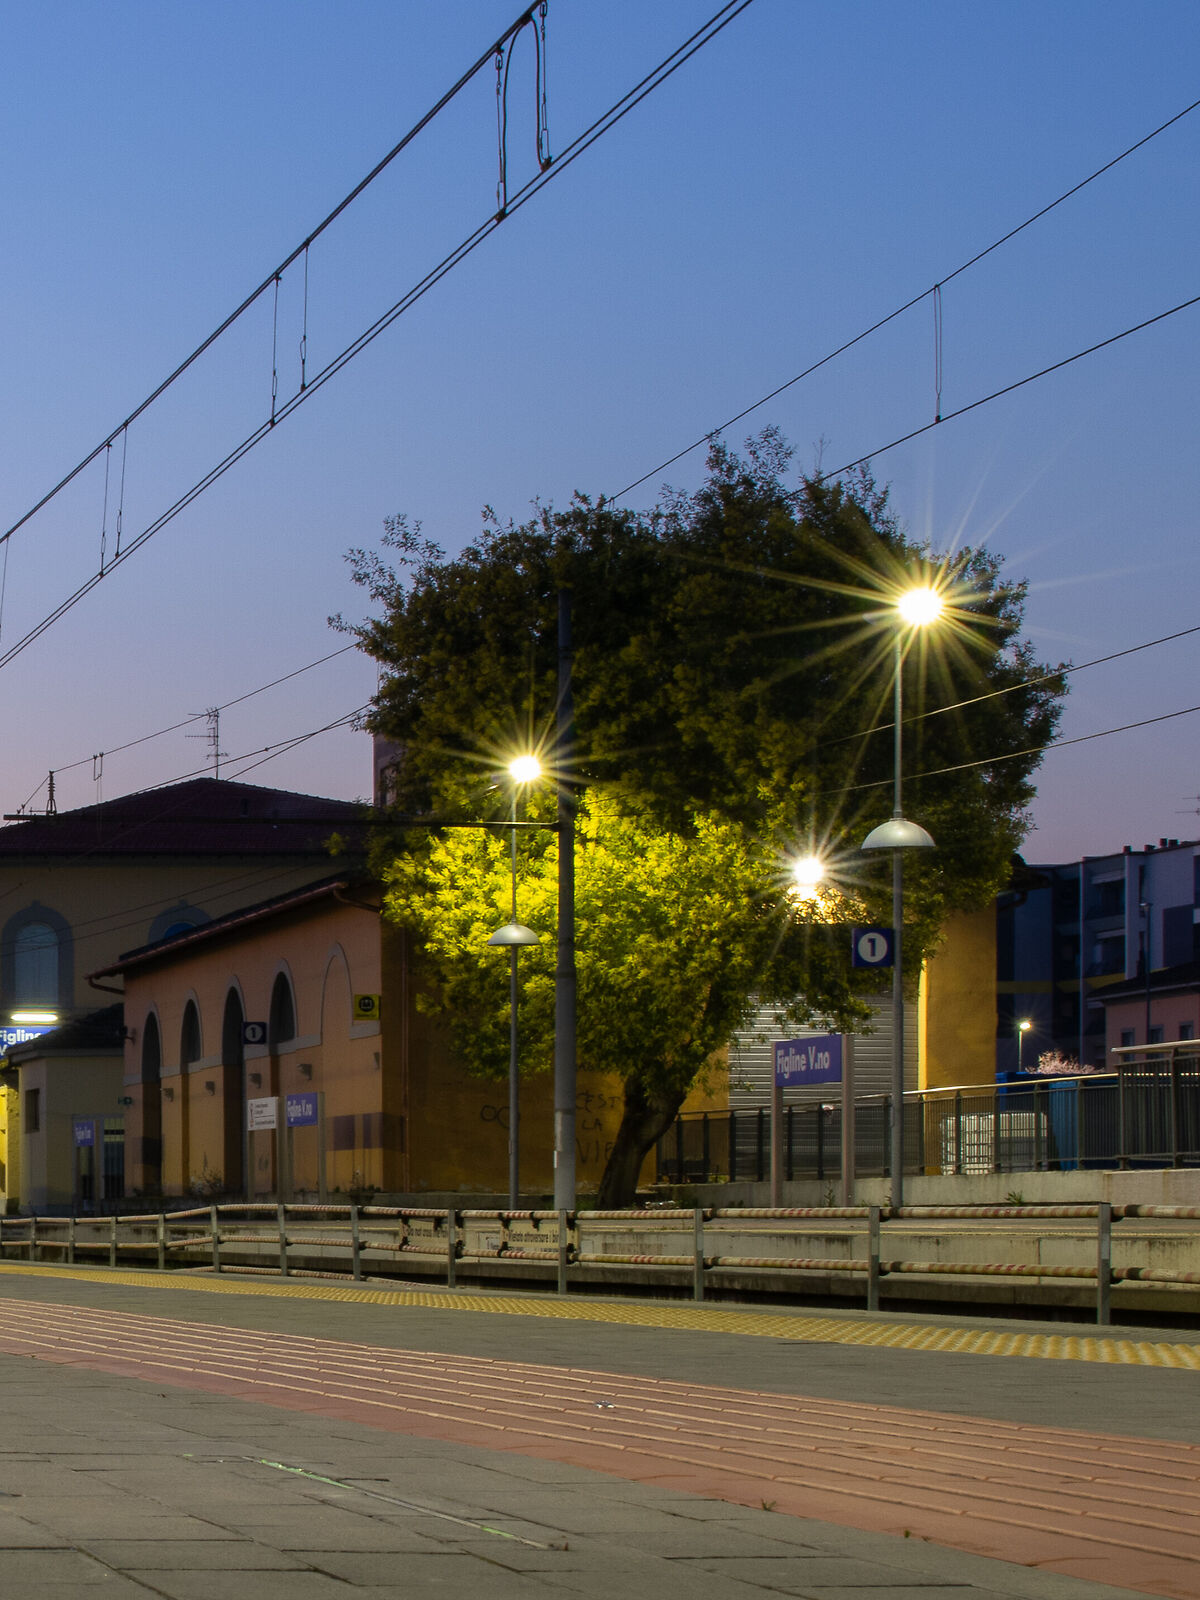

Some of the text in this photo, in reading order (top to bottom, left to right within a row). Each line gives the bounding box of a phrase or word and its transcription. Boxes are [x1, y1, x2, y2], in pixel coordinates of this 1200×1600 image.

[867, 938, 876, 957] 1
[250, 1028, 257, 1038] 1
[777, 1046, 830, 1078] Figline V.no
